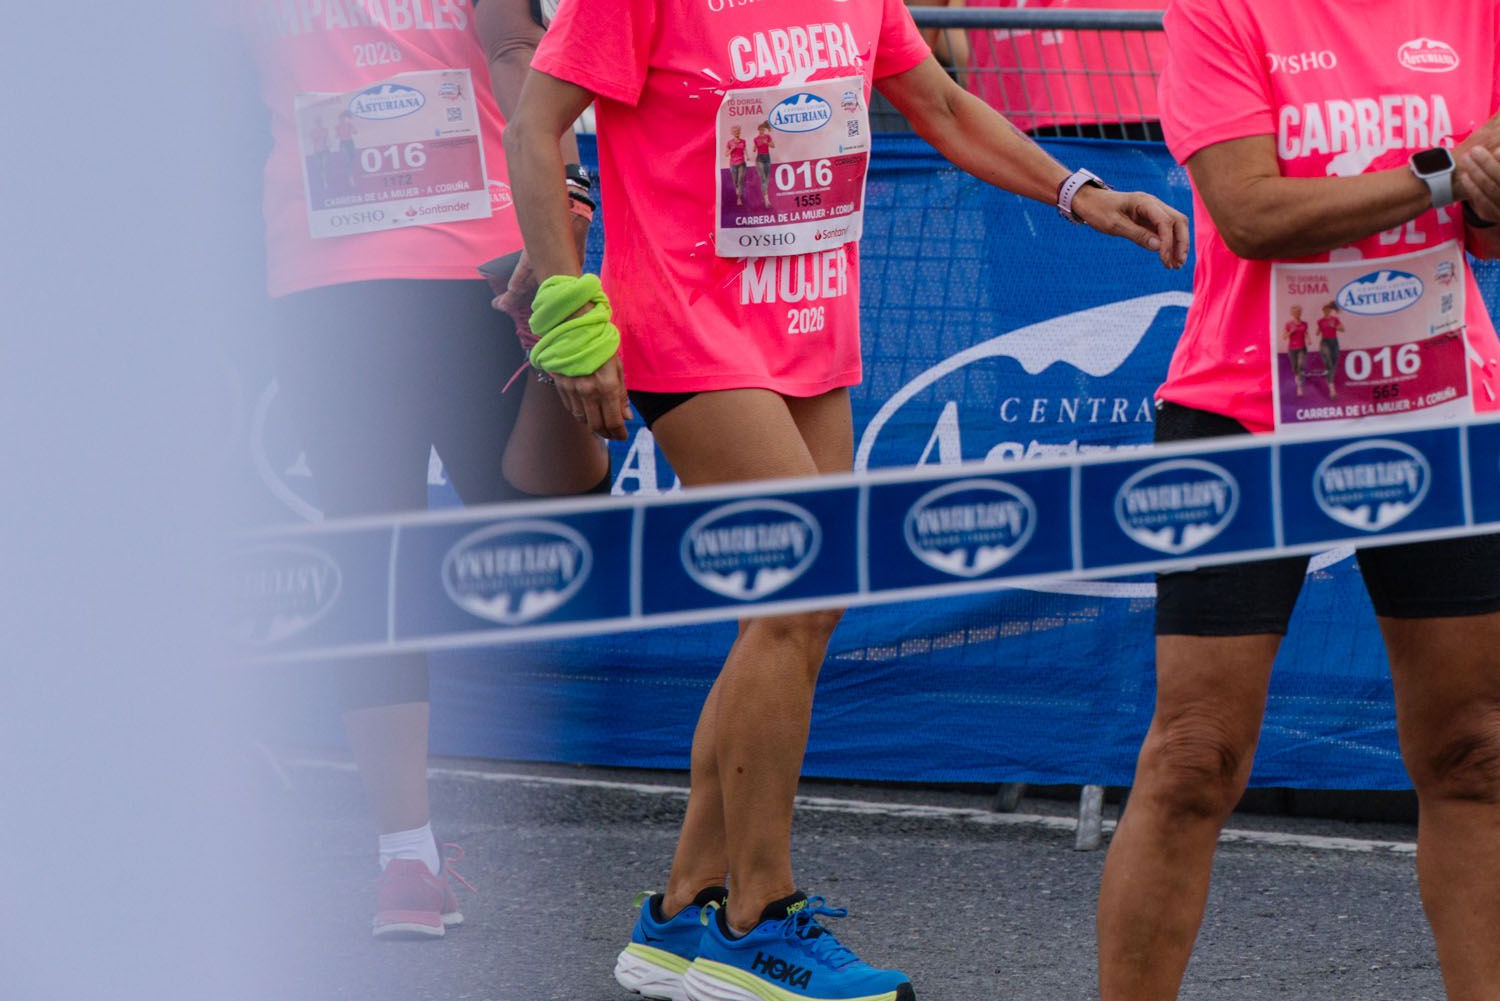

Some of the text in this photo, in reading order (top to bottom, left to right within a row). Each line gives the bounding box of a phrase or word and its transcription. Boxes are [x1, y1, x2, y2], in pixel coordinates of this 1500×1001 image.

[351, 40, 403, 68] 2026
[729, 23, 863, 82] CARRERA
[355, 94, 421, 114] ASTURIANA
[728, 104, 764, 117] SUMA
[774, 109, 829, 125] ASTURIANA
[1279, 94, 1455, 160] CARRERA
[360, 143, 427, 173] 016
[775, 159, 833, 192] 016
[794, 194, 822, 207] 1555
[330, 201, 471, 228] OYSHO Santander
[736, 215, 776, 225] CARRERA
[778, 213, 789, 223] DE
[790, 211, 800, 221] LA
[802, 208, 826, 220] MUJER
[739, 226, 850, 248] OYSHO Santan
[739, 250, 848, 305] MUJER
[1287, 282, 1330, 295] SUMA
[1344, 287, 1419, 307] ASTURIANA
[788, 306, 825, 335] 2026
[1344, 343, 1422, 381] 016
[1000, 397, 1153, 423] CENTRA
[1296, 406, 1343, 420] CARRERA
[1345, 405, 1360, 417] DE
[1361, 403, 1375, 415] LA
[1376, 400, 1411, 413] MUJER
[751, 951, 813, 991] HOKA
